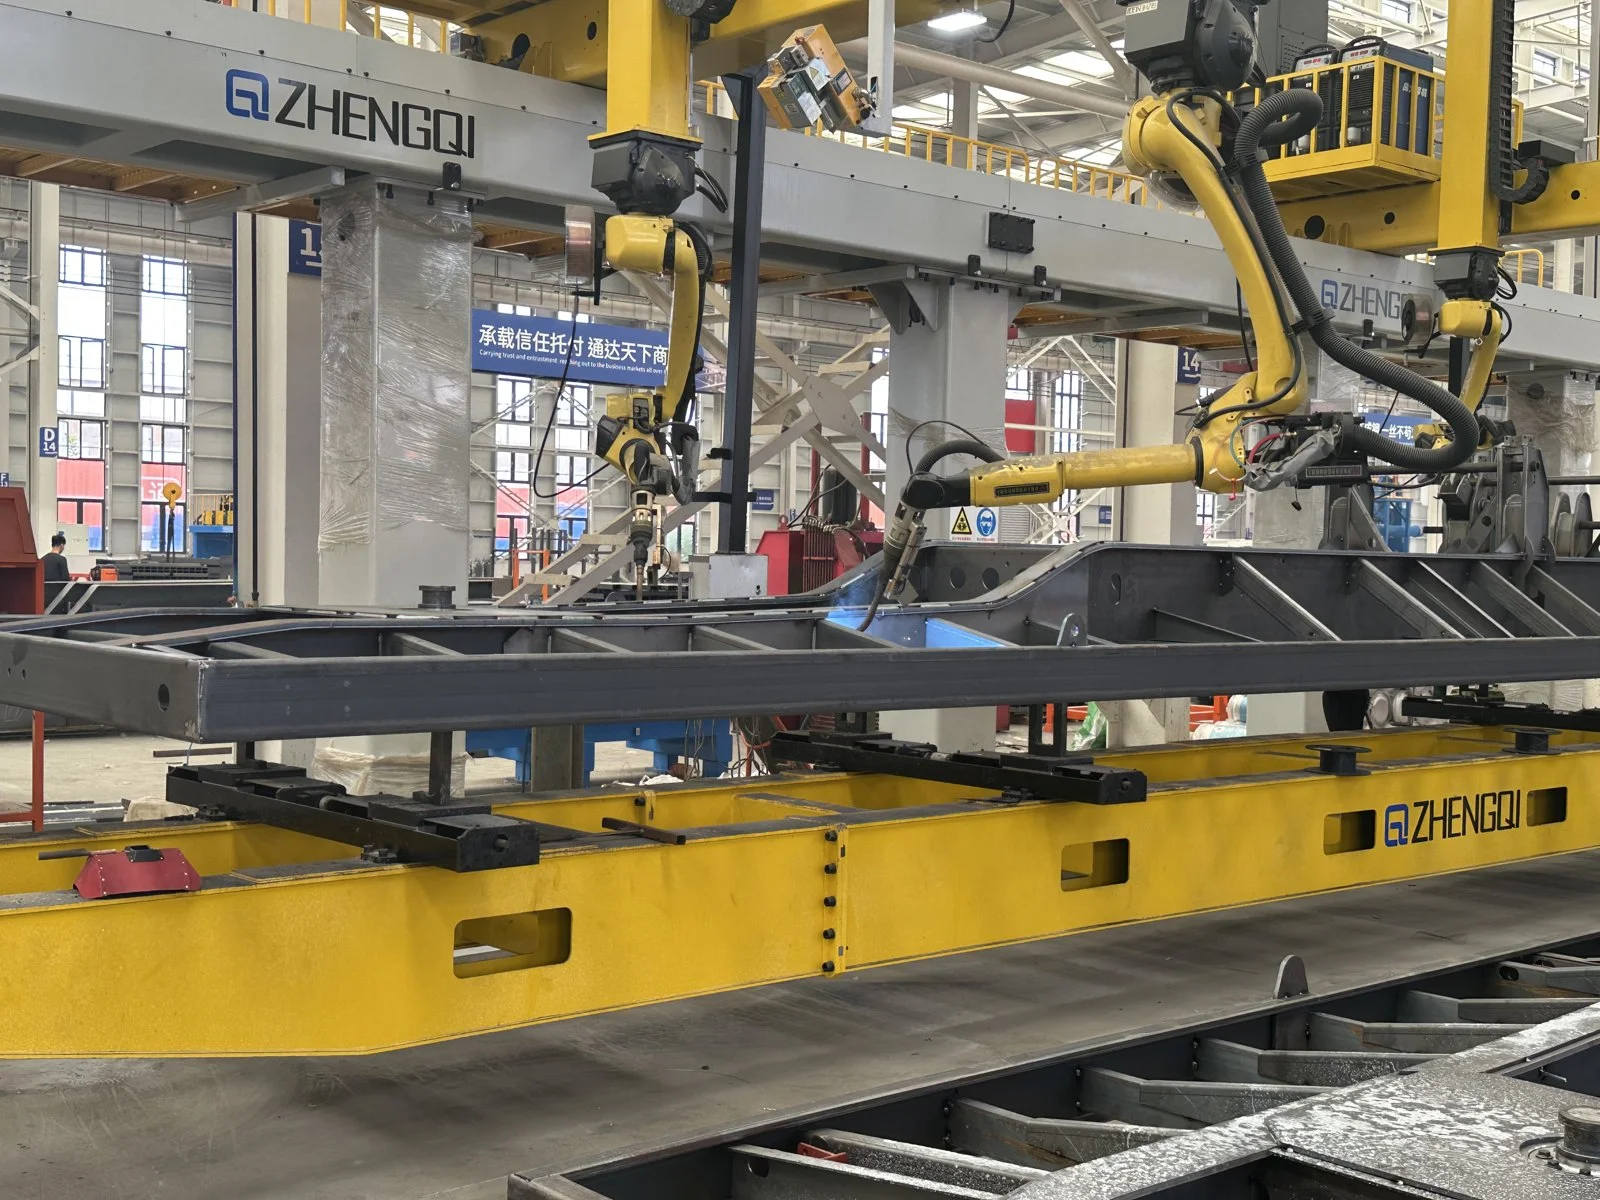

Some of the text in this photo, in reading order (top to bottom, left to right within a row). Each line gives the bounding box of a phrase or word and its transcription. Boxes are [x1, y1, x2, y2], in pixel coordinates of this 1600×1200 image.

[275, 77, 475, 159] ZHENGQI
[1339, 282, 1402, 319] ZHENG
[479, 324, 584, 357] 承载信任托付
[479, 349, 502, 359] Carrying
[526, 355, 558, 364] entrustment
[597, 361, 605, 369] the
[605, 362, 626, 371] business
[626, 365, 646, 373] markets
[1182, 351, 1200, 371] 14
[44, 428, 56, 442] D
[1381, 424, 1414, 440] 一丝不苟
[43, 441, 56, 452] 14
[1411, 789, 1521, 844] ZHENGQI
